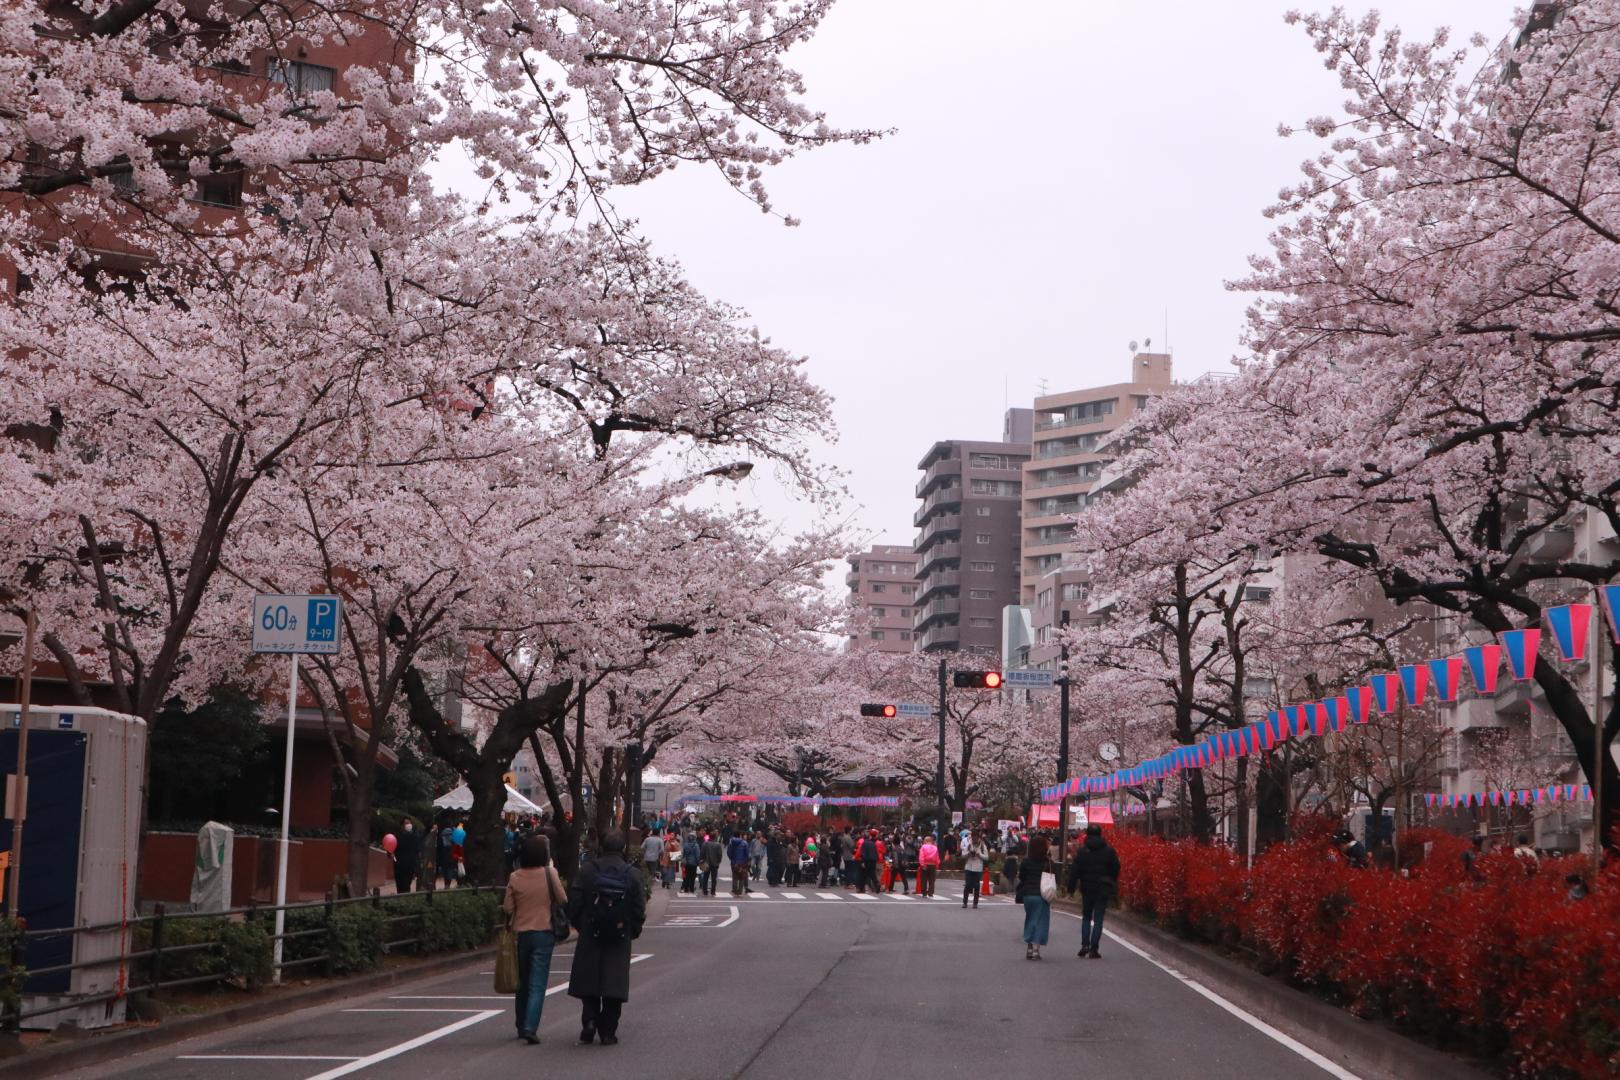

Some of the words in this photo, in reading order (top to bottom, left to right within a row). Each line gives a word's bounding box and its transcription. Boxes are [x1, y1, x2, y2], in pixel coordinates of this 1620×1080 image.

[262, 605, 298, 631] 60分
[315, 602, 331, 626] P
[310, 628, 332, 639] 9-19
